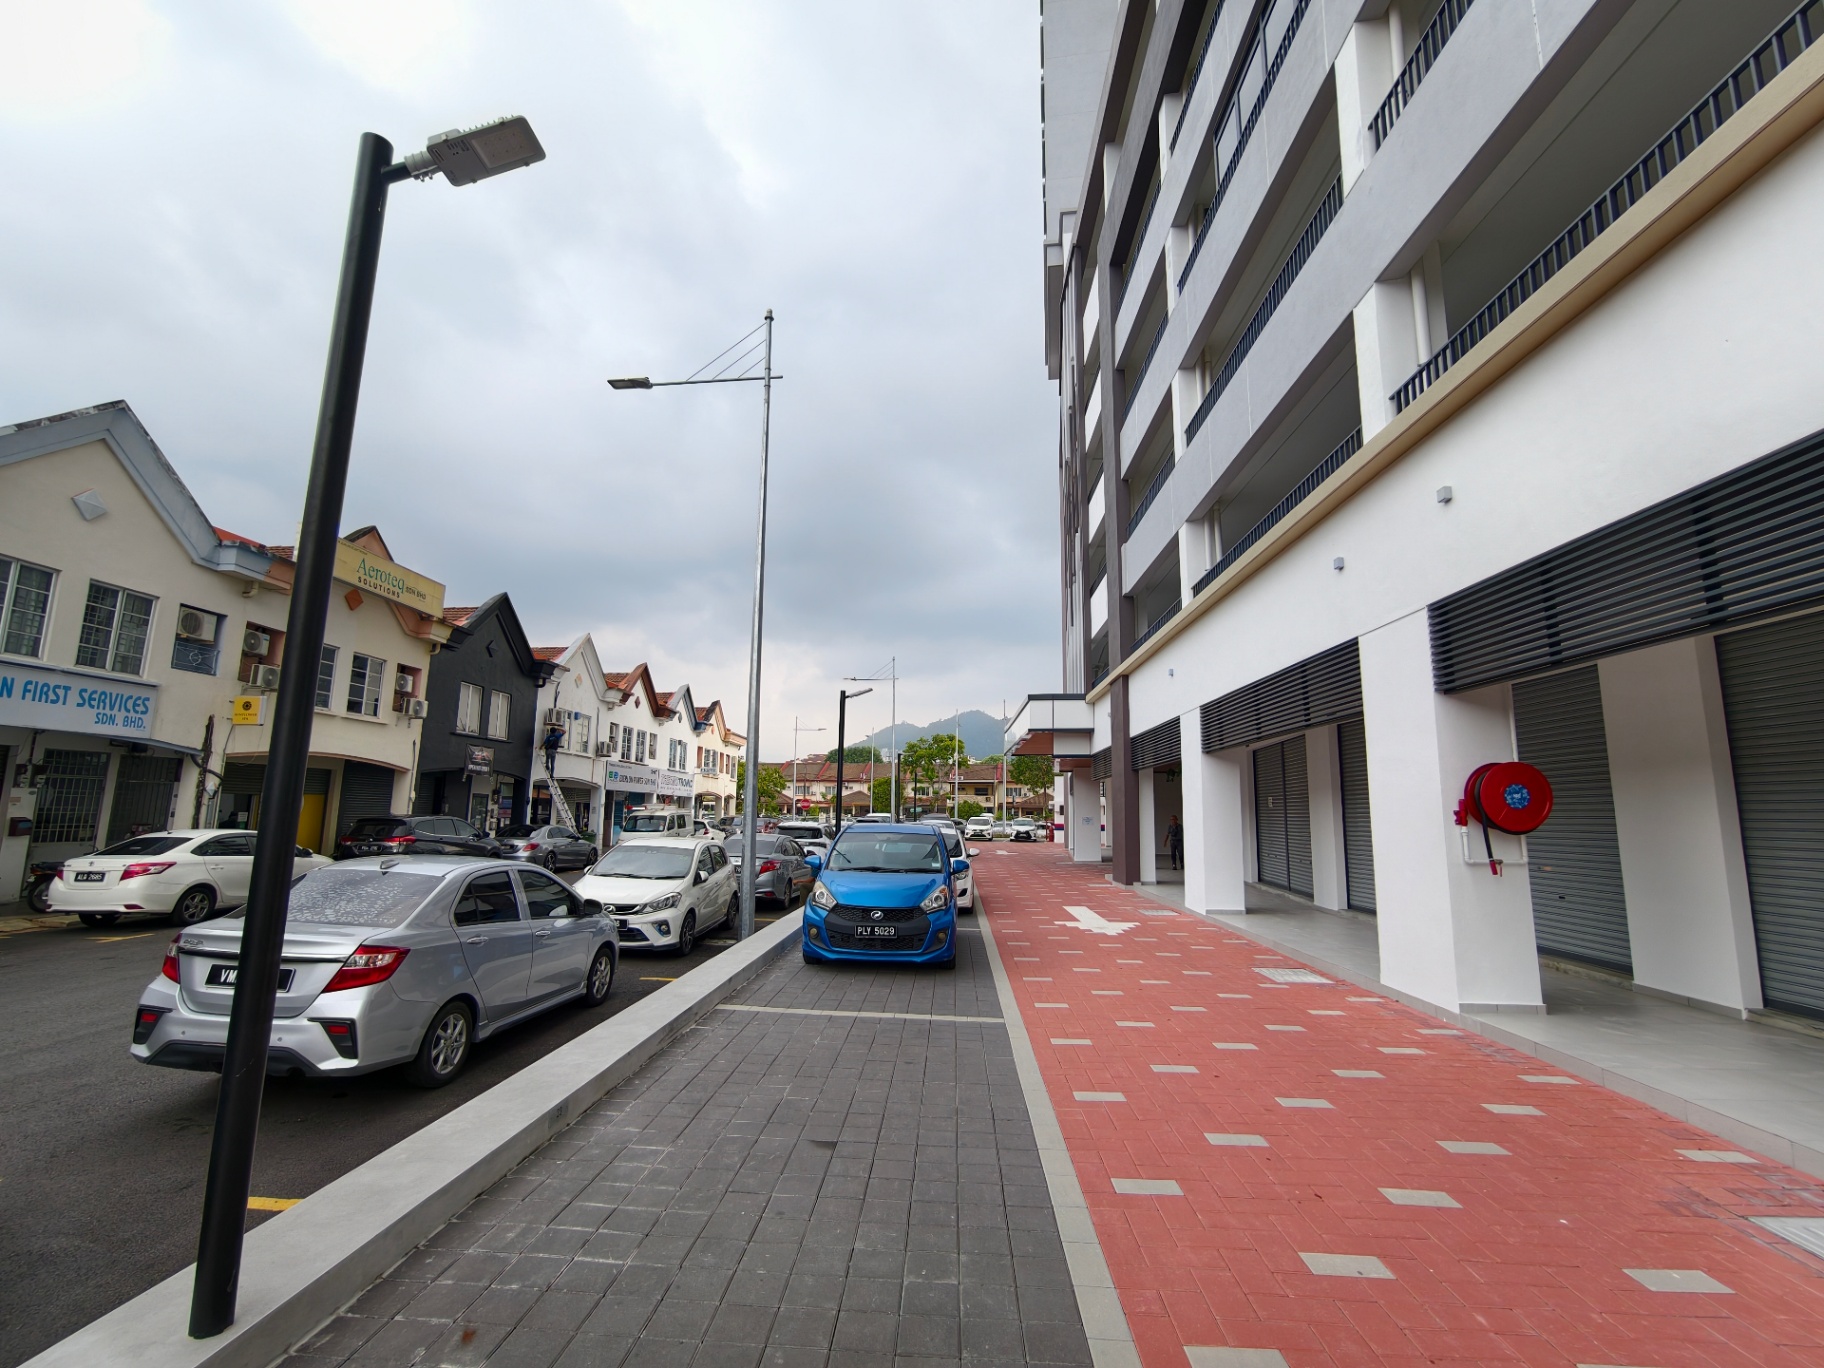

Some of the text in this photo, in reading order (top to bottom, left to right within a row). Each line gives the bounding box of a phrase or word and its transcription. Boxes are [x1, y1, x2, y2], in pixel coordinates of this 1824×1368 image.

[356, 557, 405, 594] Aeroteq
[357, 576, 401, 599] SOLUTIONS
[21, 679, 72, 706] FIRST
[76, 688, 151, 715] SERVICES
[94, 712, 146, 730] SDN. BHD.
[857, 926, 895, 935] PLY 5029
